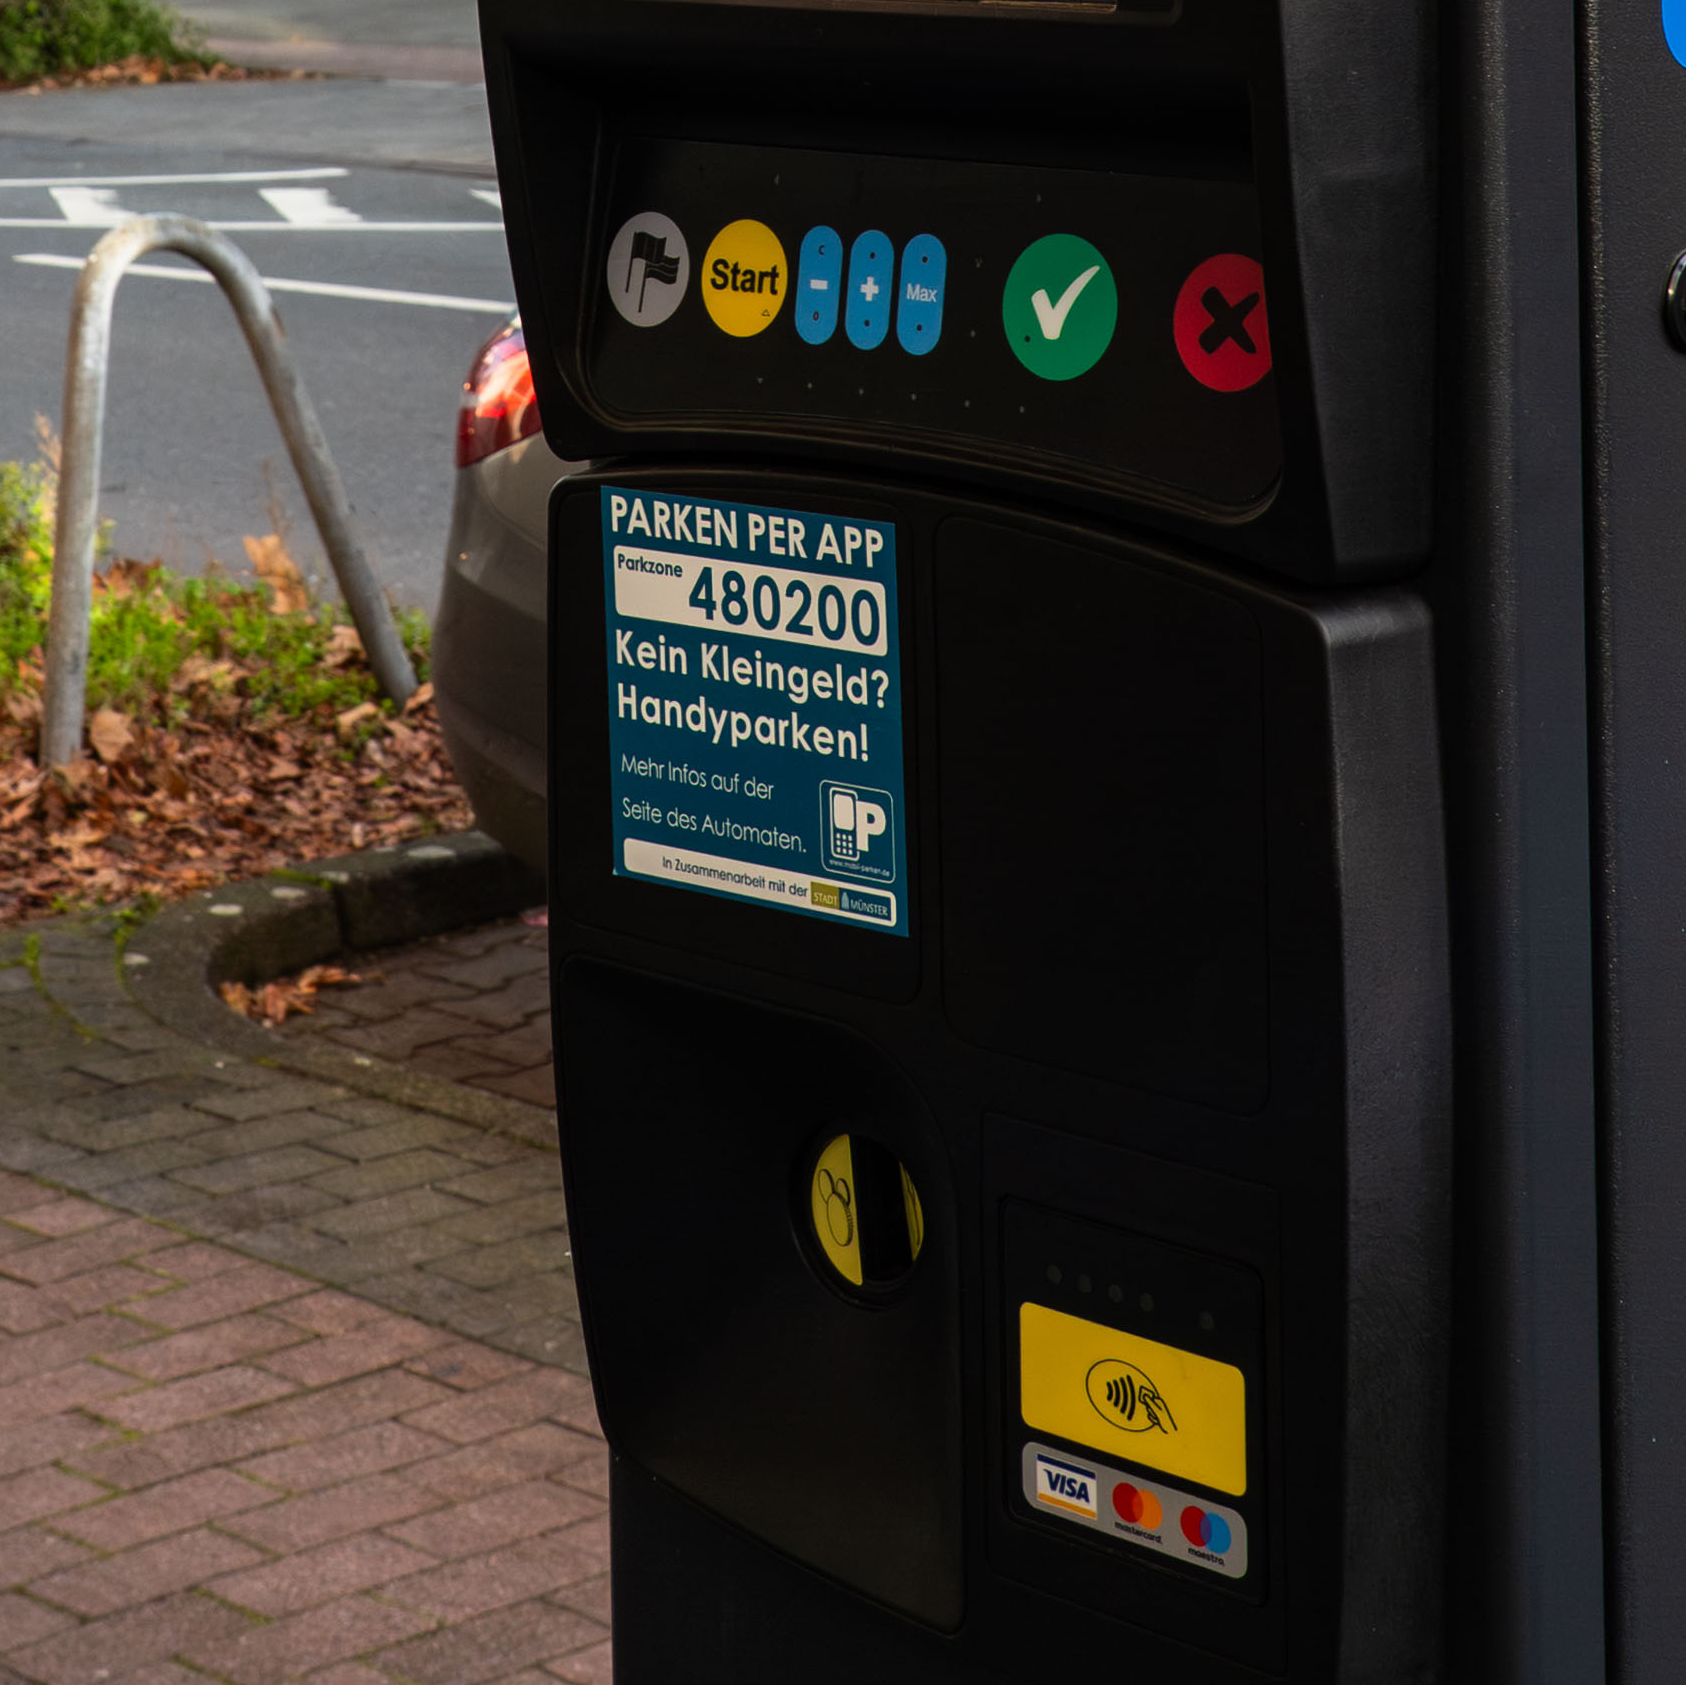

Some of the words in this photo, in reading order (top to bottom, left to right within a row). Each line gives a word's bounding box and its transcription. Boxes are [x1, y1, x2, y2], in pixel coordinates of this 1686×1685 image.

[710, 258, 780, 296] Start
[905, 283, 938, 303] Max
[610, 495, 738, 549] PARKEN
[748, 513, 808, 558] PER
[816, 523, 884, 568] APP
[618, 553, 682, 578] Parkzone
[689, 566, 881, 647] 480200
[616, 629, 688, 675] Kein
[701, 643, 889, 708] Kleingeld?
[617, 682, 869, 762] Handyparken!
[621, 753, 665, 779] Mehr
[668, 761, 707, 787] Infos
[711, 773, 740, 794] auf
[744, 776, 774, 800] der
[622, 797, 662, 824] Seite
[667, 807, 697, 831] des
[702, 815, 807, 853] Automaten.
[662, 856, 673, 869] In
[674, 858, 766, 889] Zusammenarbeit
[769, 879, 786, 893] mit
[789, 882, 809, 897] der
[814, 892, 838, 906] STADT
[850, 898, 888, 916] MÜNSTER
[1042, 1468, 1090, 1504] VISA
[1114, 1521, 1162, 1544] mastercard
